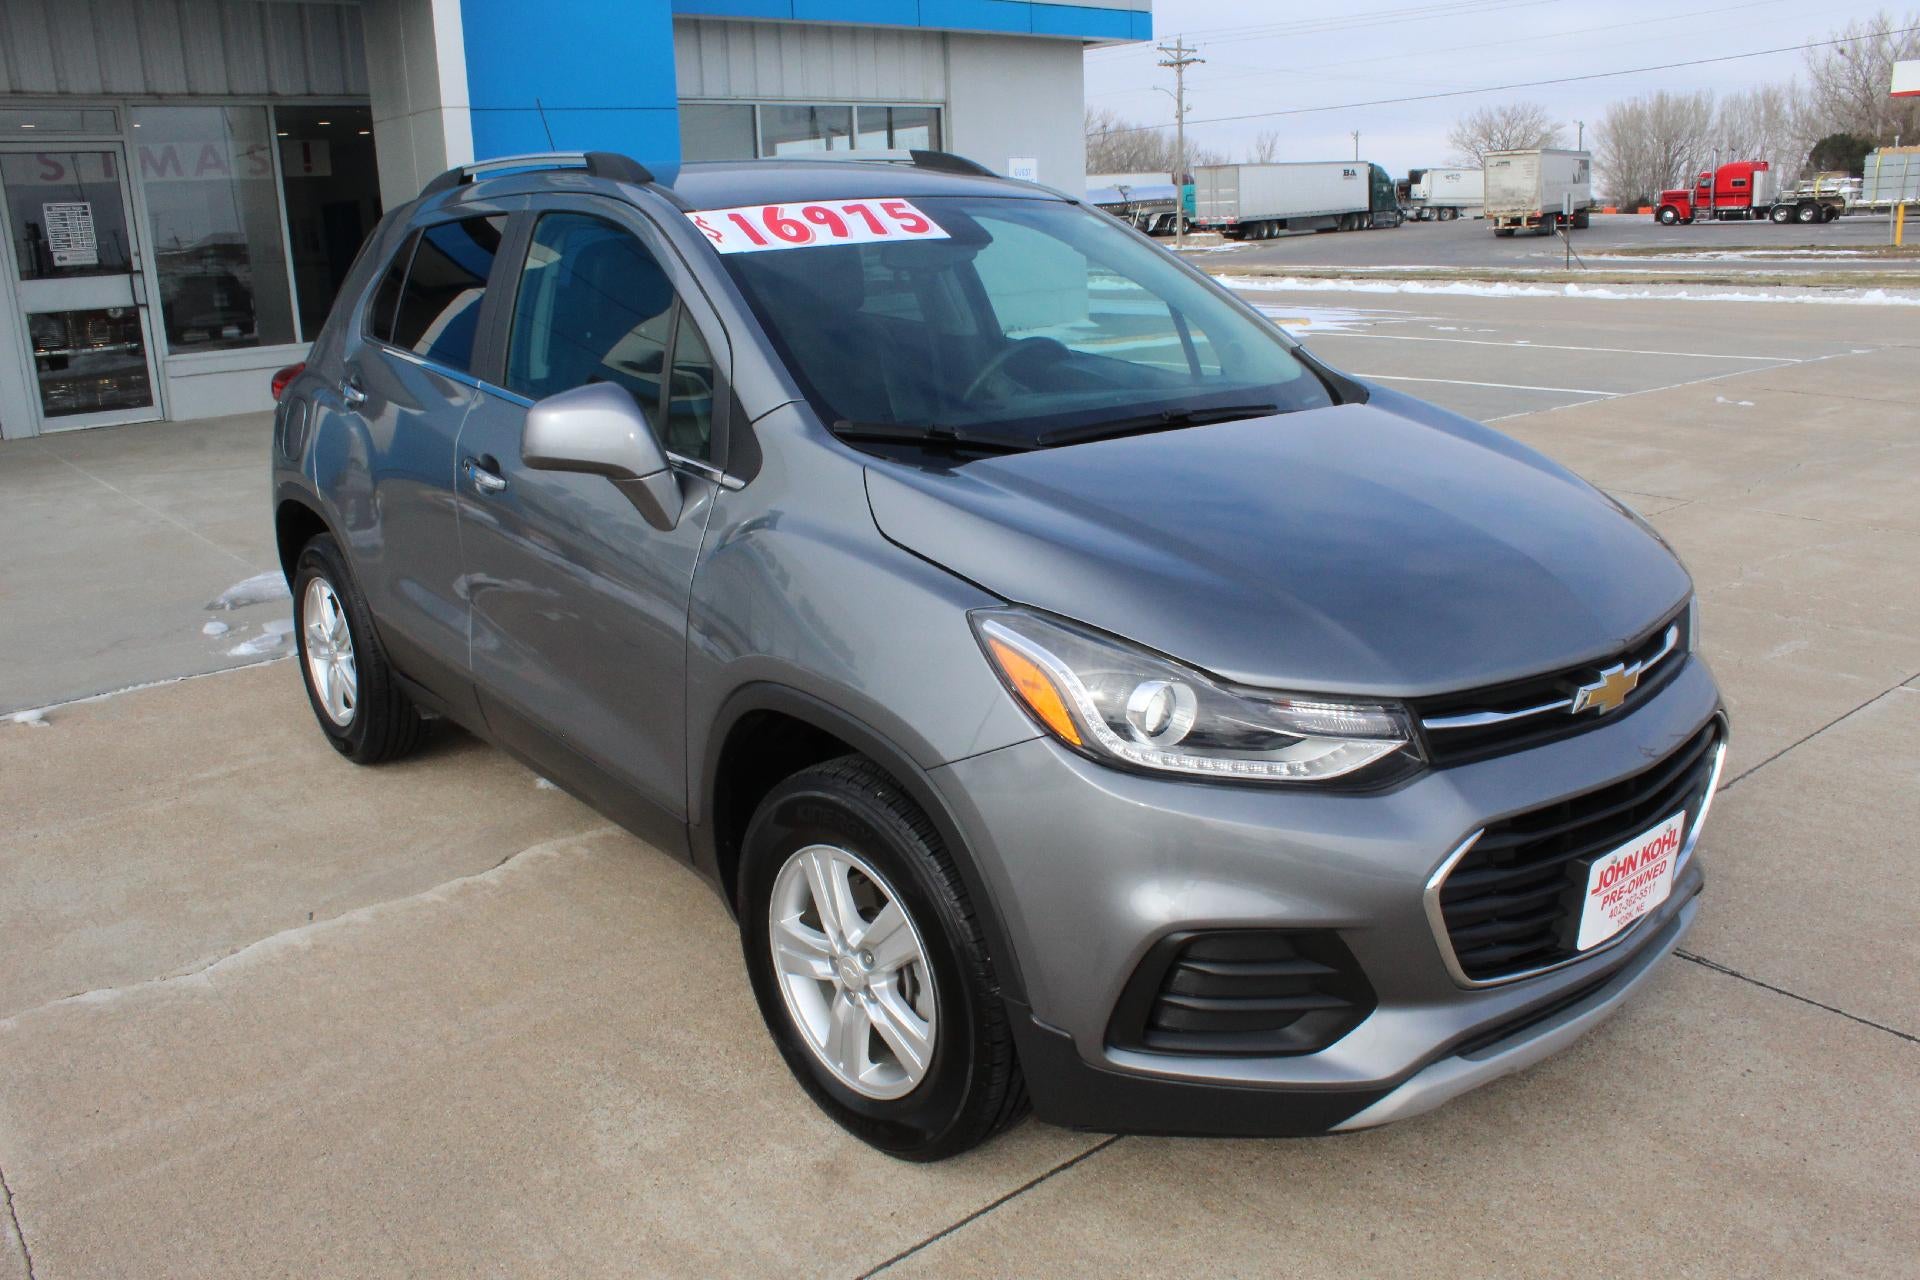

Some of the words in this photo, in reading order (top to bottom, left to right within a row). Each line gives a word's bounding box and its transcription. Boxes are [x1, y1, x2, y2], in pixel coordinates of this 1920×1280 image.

[1591, 850, 1639, 896] JOHN
[1640, 829, 1678, 866] KOHL
[1600, 860, 1667, 911] PRE-OWNED
